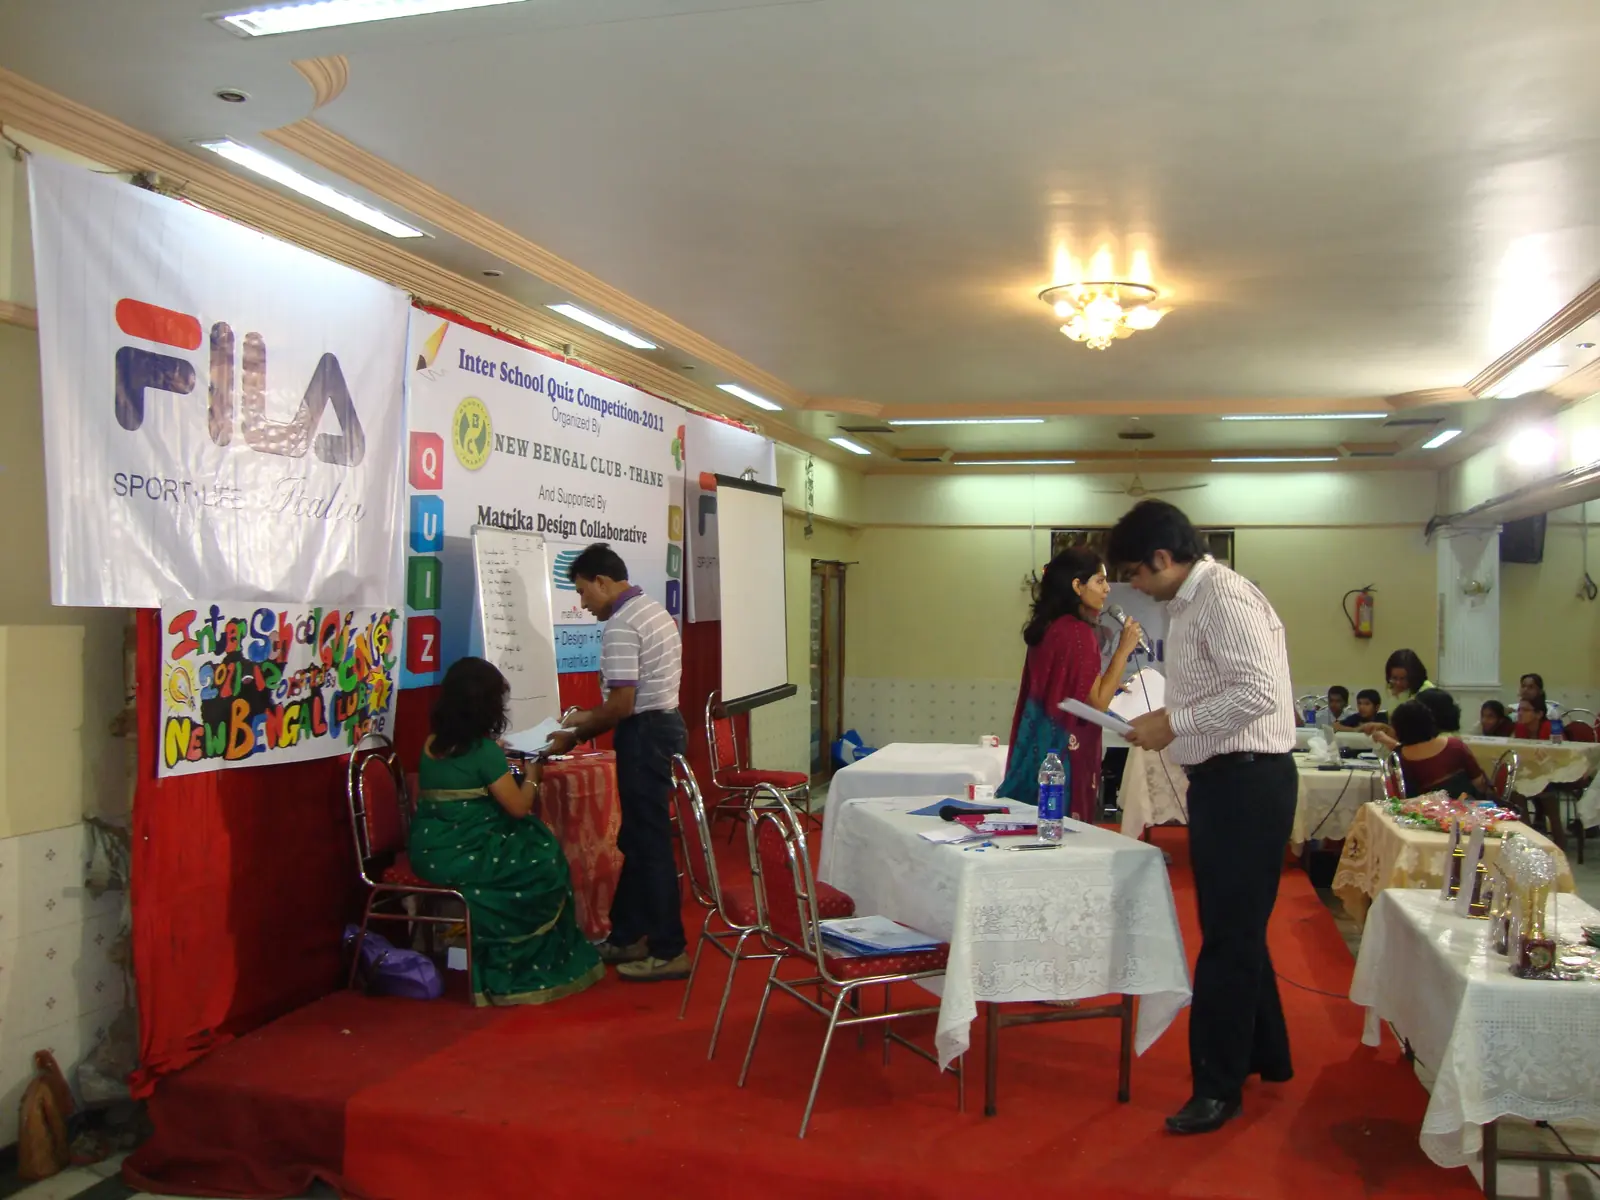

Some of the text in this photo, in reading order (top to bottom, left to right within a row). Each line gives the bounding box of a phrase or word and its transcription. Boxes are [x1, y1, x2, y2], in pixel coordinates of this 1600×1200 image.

[115, 298, 366, 467] FILA
[459, 348, 664, 433] Inter School Quiz Competition-2011
[552, 406, 601, 437] Organized By
[494, 433, 530, 458] NEW
[533, 442, 587, 471] BENGAL
[590, 455, 622, 478] CLUB
[629, 466, 663, 487] THANE
[478, 505, 647, 544] Matrika Design Collaborative
[538, 485, 607, 514] And Supported By
[168, 604, 248, 661] Inter
[562, 630, 588, 648] Design
[223, 695, 328, 762] BENGAL
